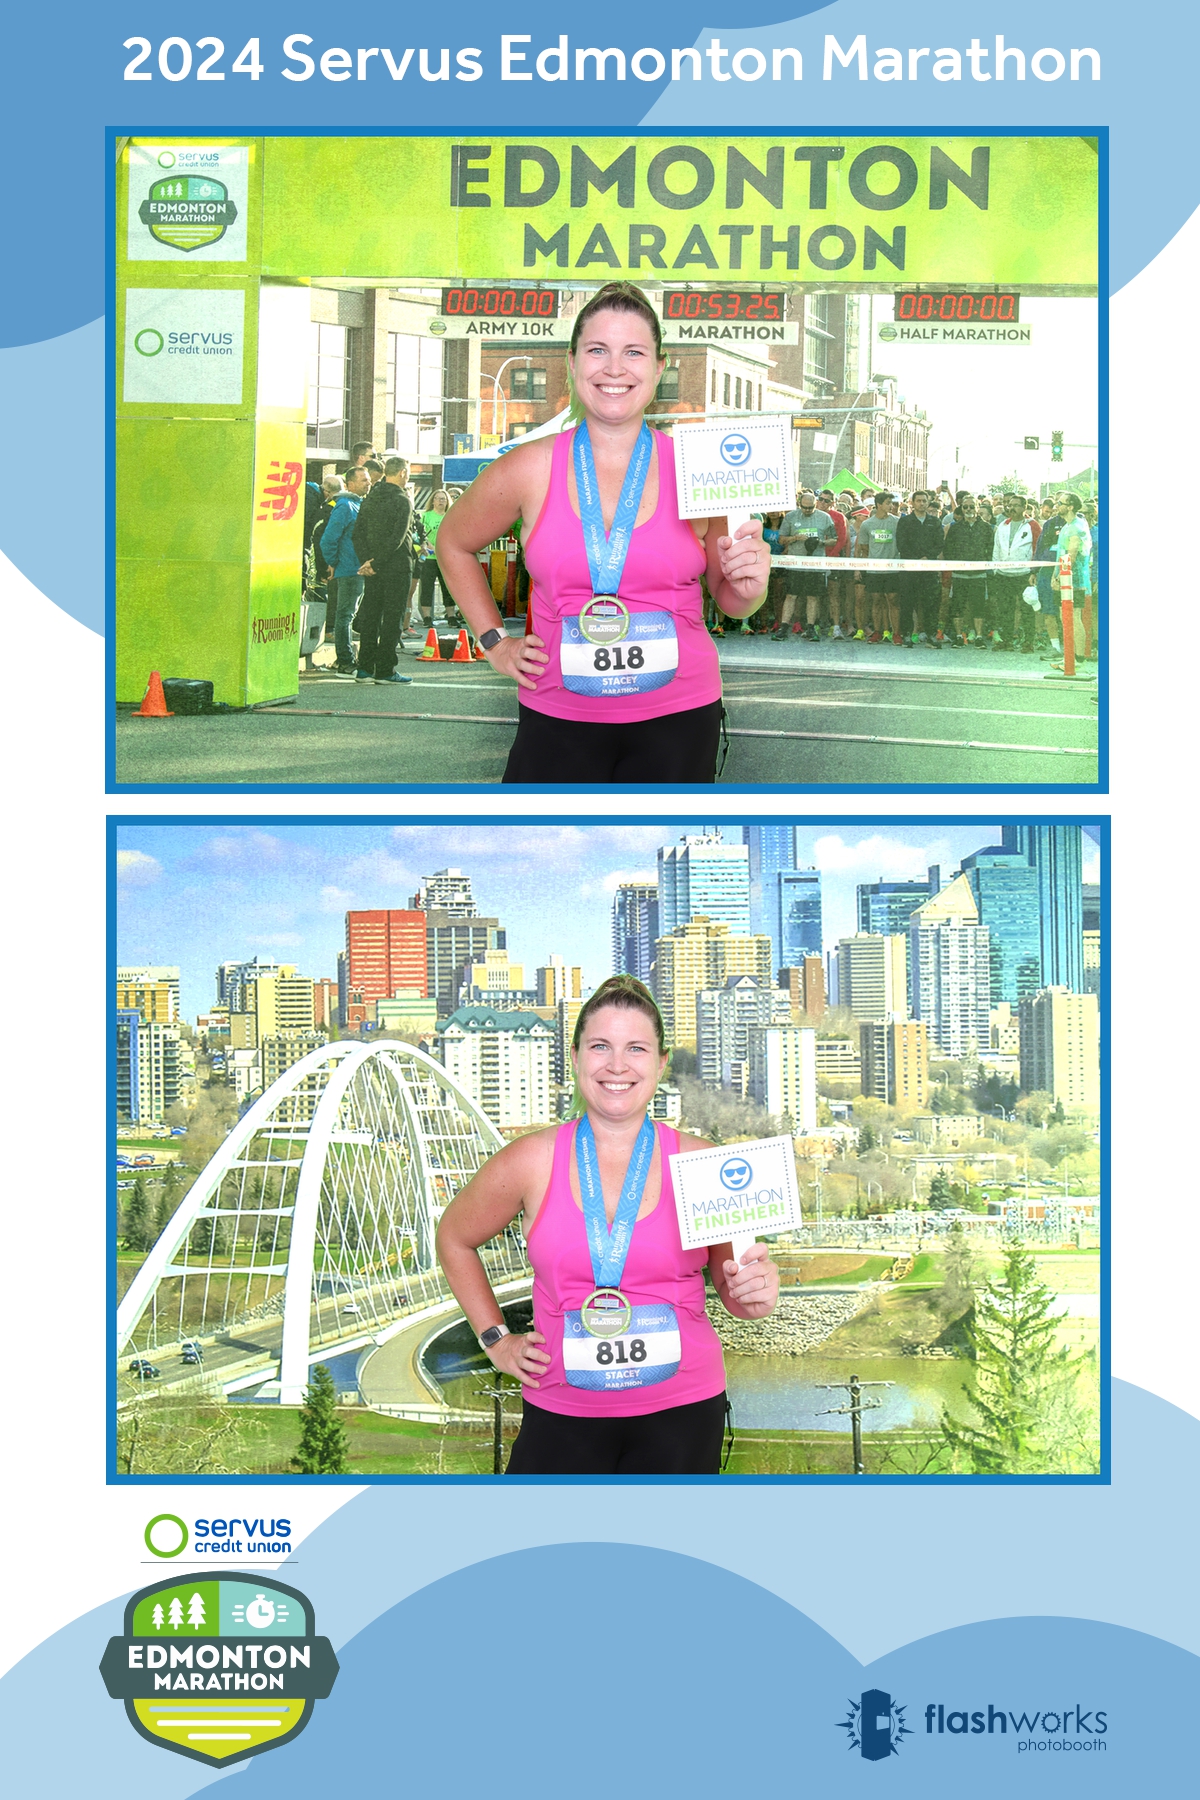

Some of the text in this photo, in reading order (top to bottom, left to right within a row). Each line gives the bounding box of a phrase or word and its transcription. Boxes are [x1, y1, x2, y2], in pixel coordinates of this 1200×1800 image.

[178, 152, 219, 161] servus
[450, 144, 990, 211] EDMONTON
[149, 203, 227, 214] EDMONTON
[160, 214, 215, 222] MARATHON
[523, 222, 907, 273] MARATHON
[465, 321, 554, 336] ARMY 10K
[678, 325, 785, 340] MARATHON
[900, 328, 1031, 340] HALF MARATHON
[168, 332, 233, 345] servus
[168, 345, 233, 355] credit union
[579, 444, 592, 505] MARATHON FINISHER
[628, 477, 640, 499] servus
[634, 460, 643, 478] credit
[691, 467, 780, 487] MARATHON
[692, 482, 781, 501] FINISHER!
[590, 524, 598, 543] union
[592, 543, 602, 565] credit
[257, 613, 291, 642] Running
[594, 646, 645, 671] 818
[602, 676, 638, 686] STACEY
[601, 687, 640, 695] MARATHON
[582, 1136, 594, 1198] MARATHON FINISHER
[631, 1170, 641, 1192] servus
[636, 1152, 645, 1170] credit
[692, 1187, 784, 1217] MARATHON
[592, 1216, 600, 1235] union
[694, 1202, 786, 1231] FINISHER!
[595, 1236, 604, 1258] credit
[596, 1339, 647, 1365] 818
[604, 1380, 643, 1388] MARATHON
[605, 1369, 641, 1380] STACEY
